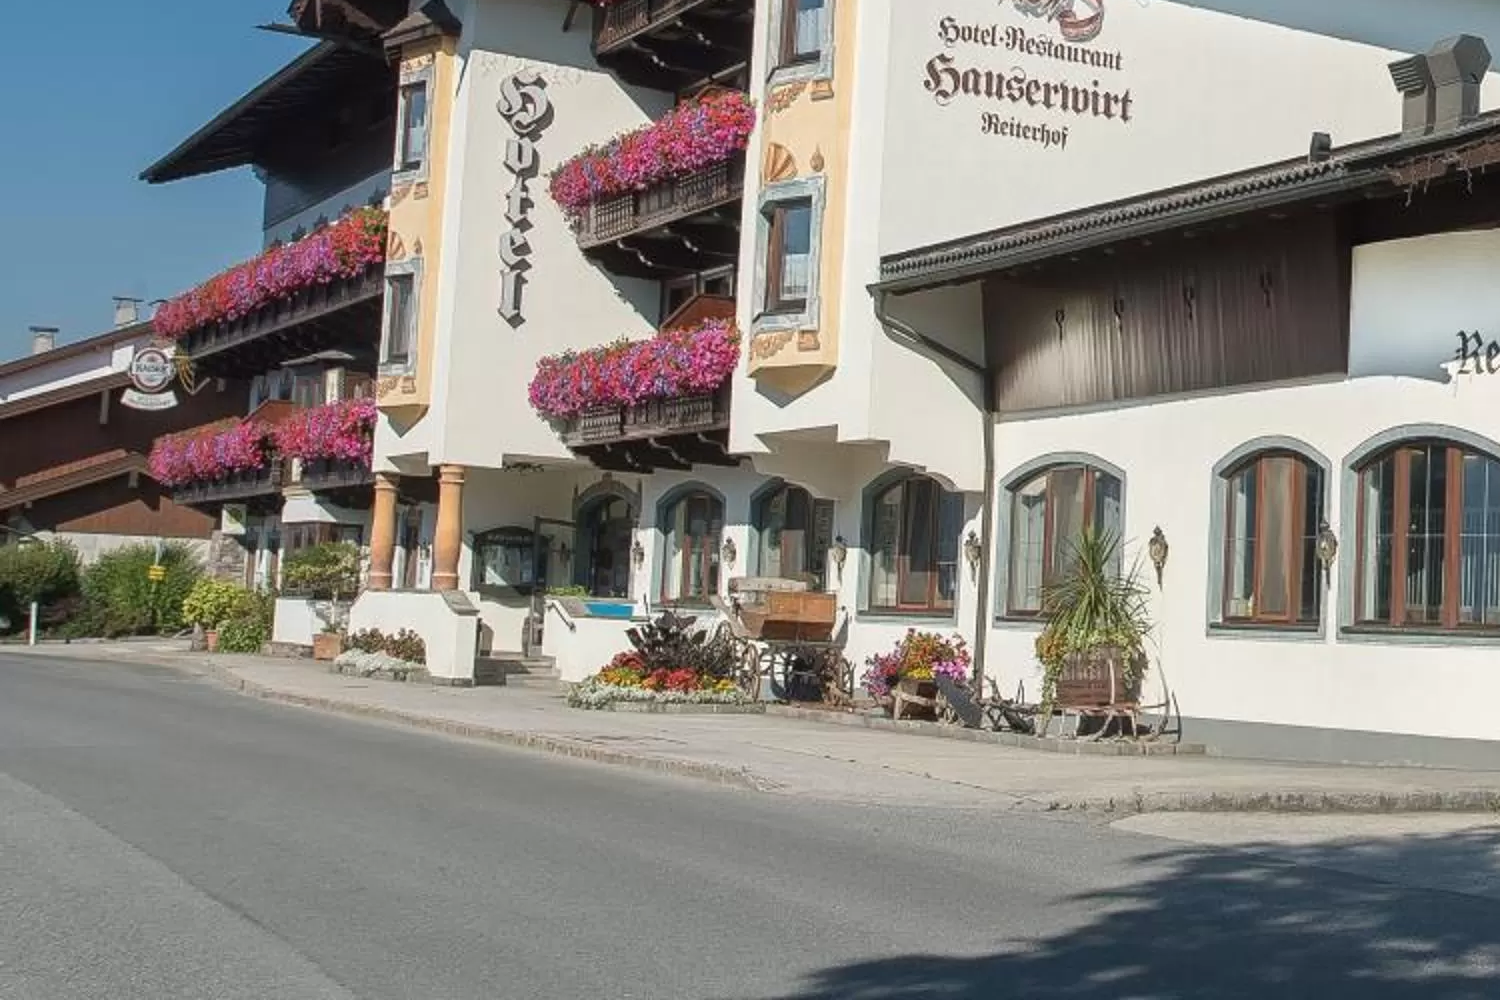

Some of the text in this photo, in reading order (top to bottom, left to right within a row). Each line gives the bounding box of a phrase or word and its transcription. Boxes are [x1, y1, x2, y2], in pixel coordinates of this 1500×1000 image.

[938, 15, 1123, 71] Hotel-Restaurant
[923, 53, 1133, 123] Hauserwirt
[981, 112, 1069, 150] Reiterhof
[496, 70, 554, 329] Hotel
